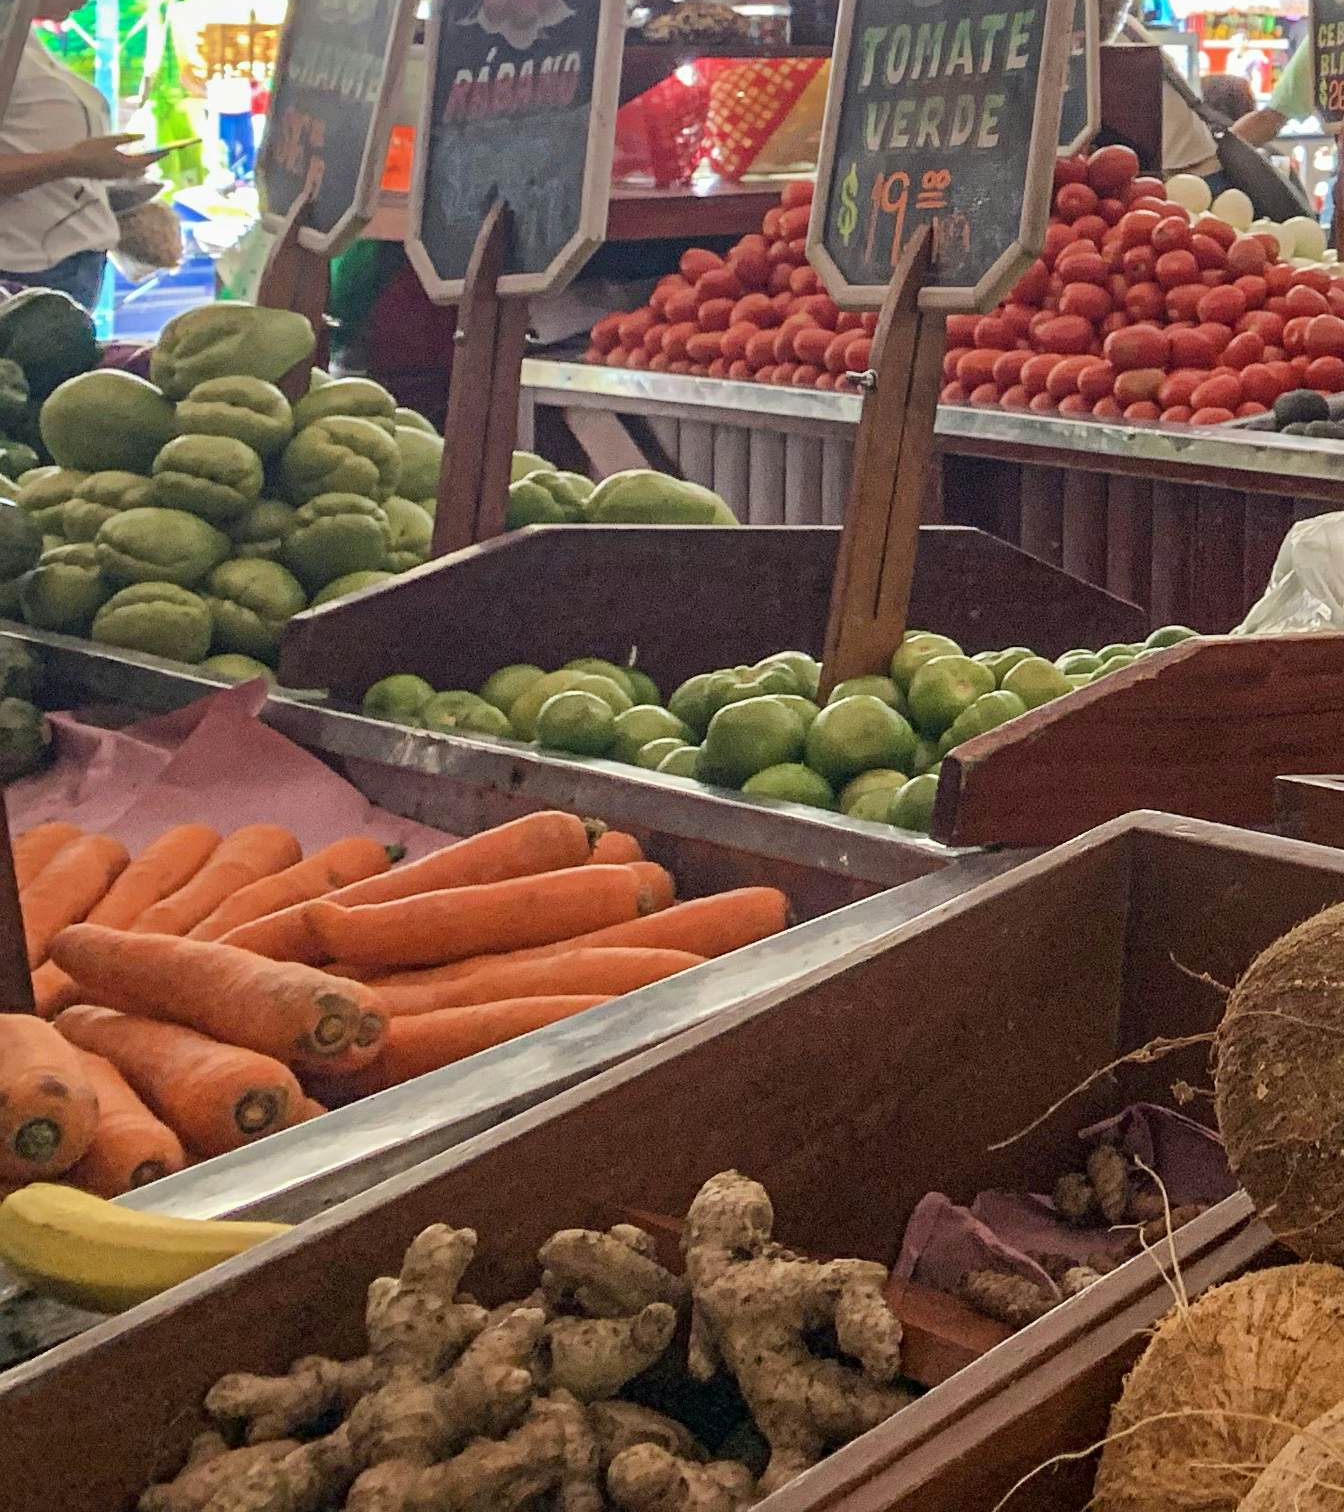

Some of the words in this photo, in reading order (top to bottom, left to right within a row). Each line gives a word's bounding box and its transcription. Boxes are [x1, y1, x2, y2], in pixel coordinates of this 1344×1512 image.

[442, 46, 580, 120] RÁBANO
[859, 9, 1036, 88] TOMATE
[864, 93, 1006, 152] VERDE
